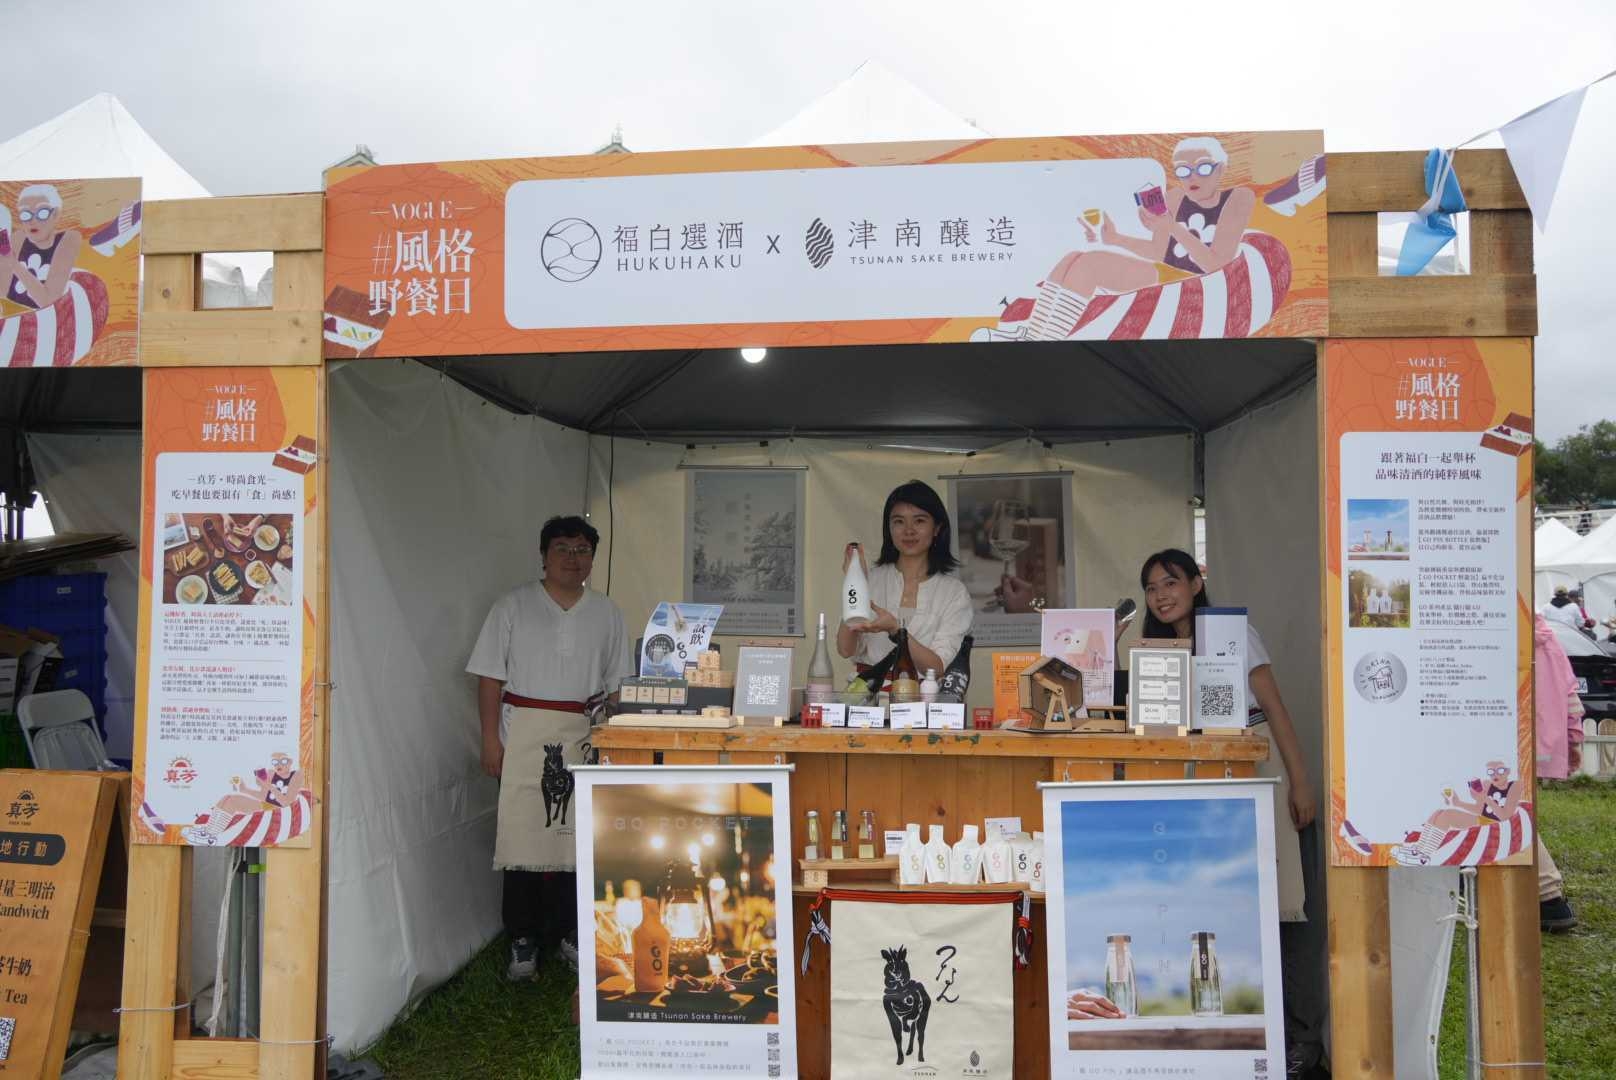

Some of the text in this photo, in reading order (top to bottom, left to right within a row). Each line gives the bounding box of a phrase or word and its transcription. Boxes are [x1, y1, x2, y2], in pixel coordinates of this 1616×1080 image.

[390, 200, 454, 221] VOGUE
[614, 221, 744, 254] 福白選酒
[371, 228, 475, 276] #風格
[850, 251, 1014, 265] TSUNAN SAKE BREWERY
[616, 254, 743, 272] HUKUHAKU
[368, 277, 472, 317] 野餐日
[1400, 373, 1461, 397] #風格
[205, 399, 257, 421] #風格
[1395, 400, 1459, 421] 野餐日
[202, 423, 256, 443] 野餐日
[1380, 452, 1477, 464] 跟著福白一起舉杯
[1375, 469, 1482, 481] 品味清酒的純粹風味
[6, 802, 40, 819] 真芳
[6, 988, 28, 1004] Tea
[660, 1012, 688, 1020] Tsunan
[691, 1013, 711, 1021] Sake
[713, 1013, 747, 1022] Brewery
